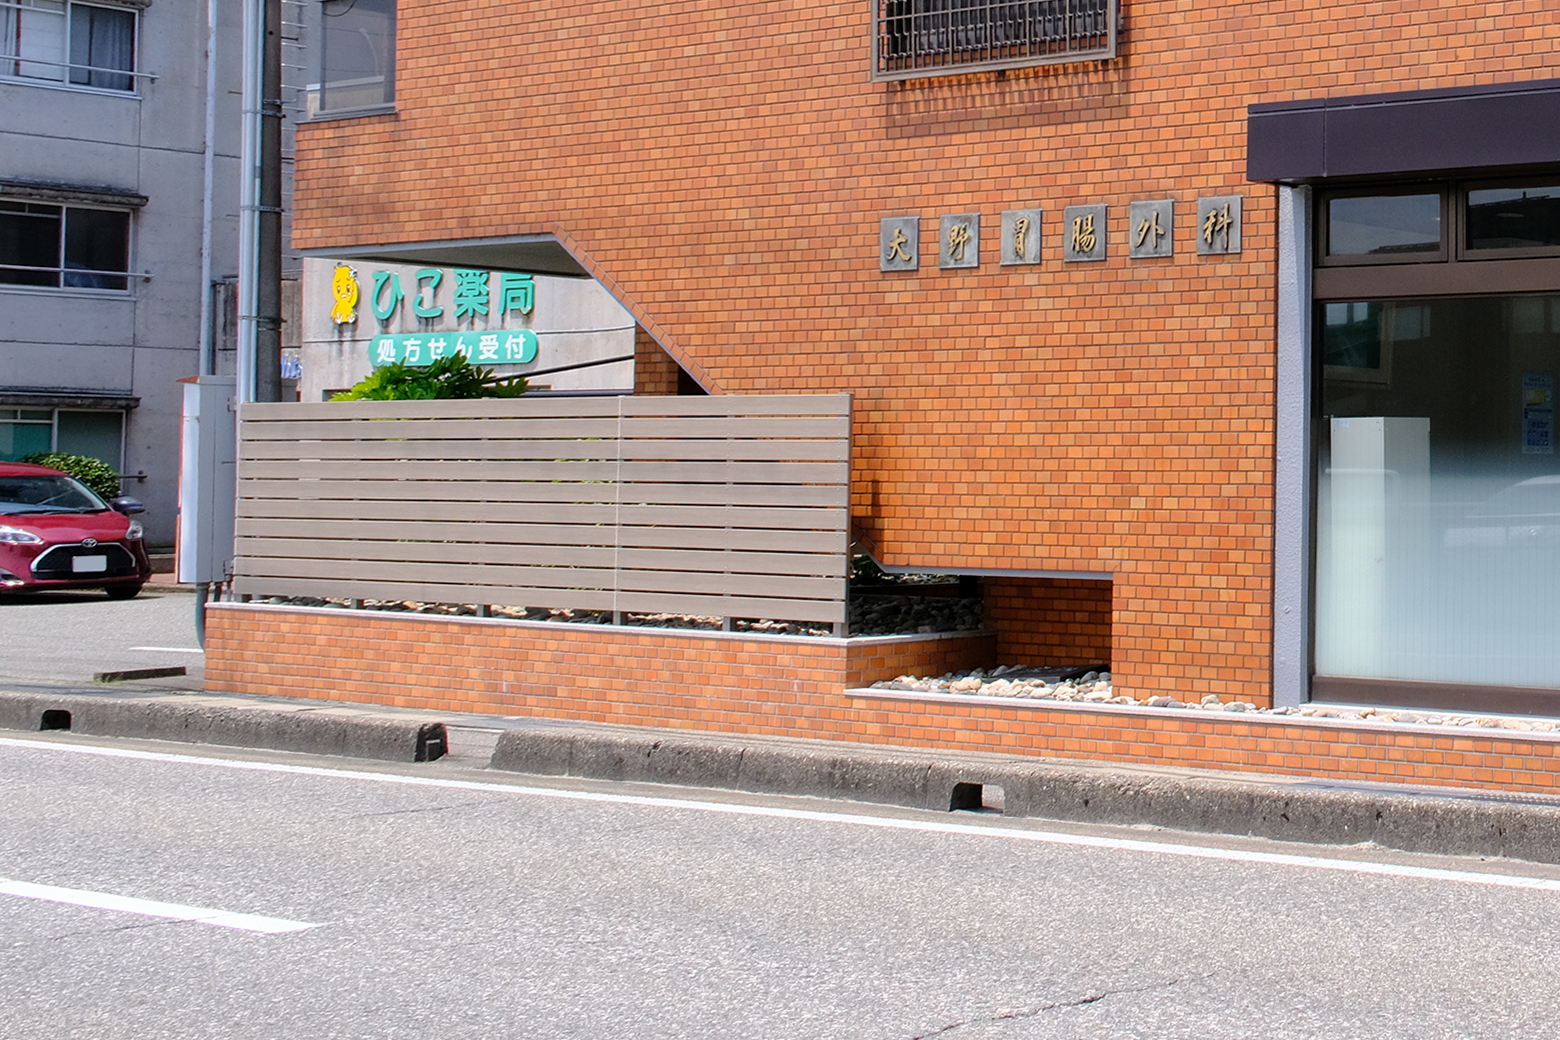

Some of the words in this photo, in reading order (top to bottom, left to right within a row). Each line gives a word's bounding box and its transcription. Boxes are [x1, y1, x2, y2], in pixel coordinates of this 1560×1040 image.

[886, 201, 1233, 261] 大野胃腸外科
[371, 268, 534, 321] ひこ薬局
[377, 333, 527, 364] 処方せん受付
